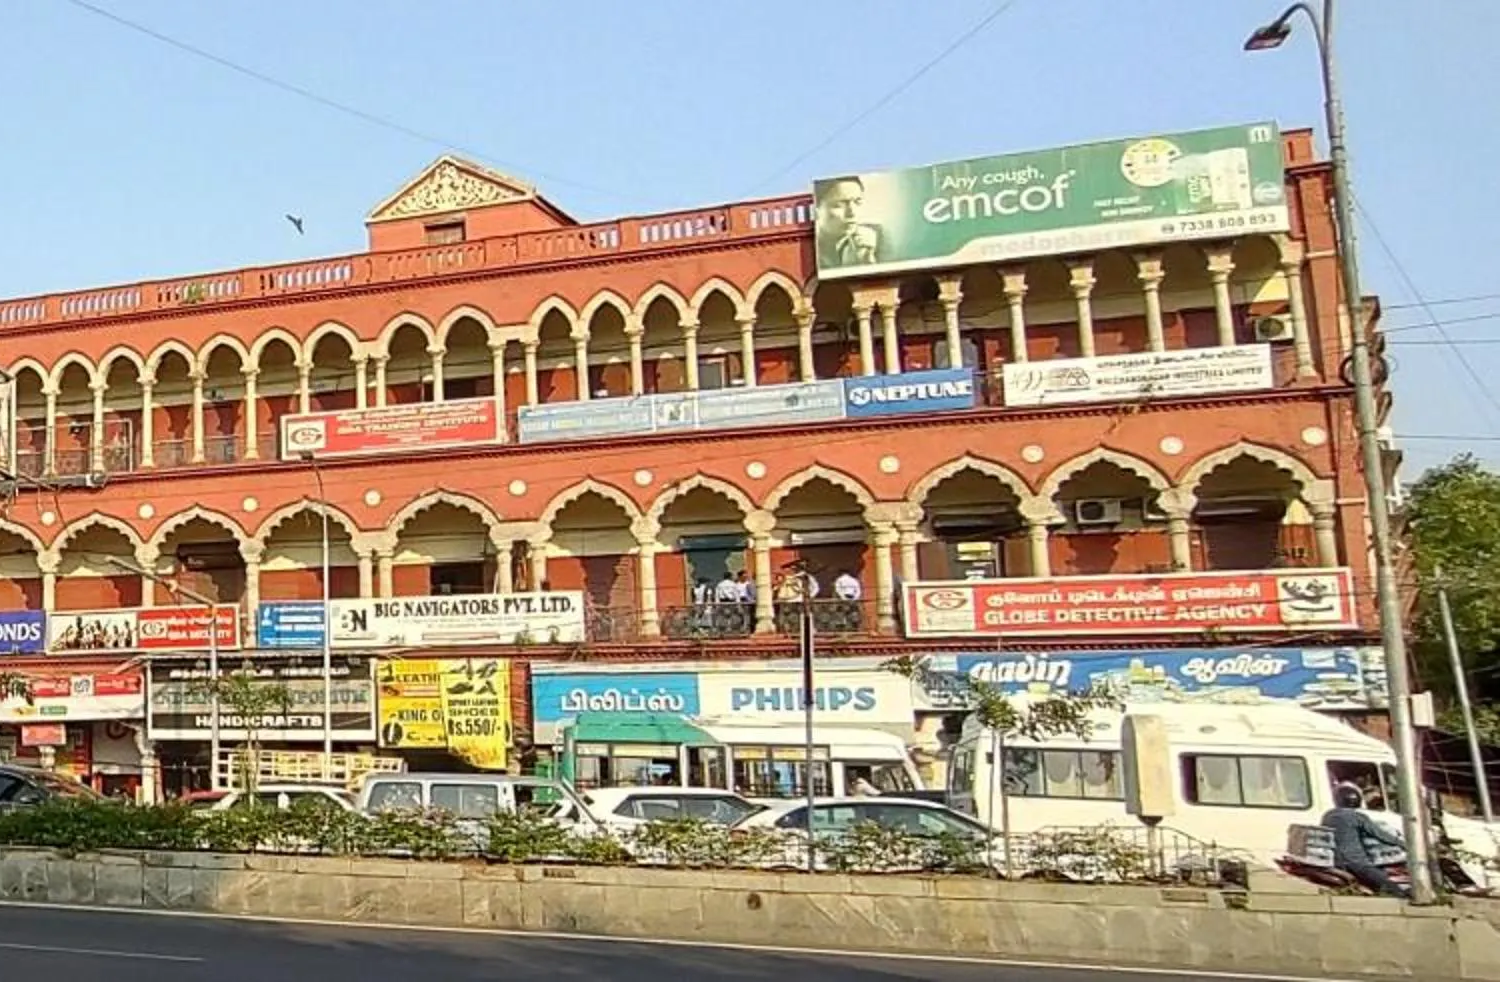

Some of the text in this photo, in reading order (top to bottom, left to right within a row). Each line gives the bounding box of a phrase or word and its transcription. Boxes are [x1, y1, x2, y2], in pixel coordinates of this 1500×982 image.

[941, 165, 1045, 191] Any cough.
[923, 173, 1070, 223] emcof
[1180, 221, 1213, 232] 7338
[872, 379, 972, 402] NEPTUNE
[373, 602, 400, 618] BIG
[403, 599, 499, 617] NAVIGATORS
[541, 597, 576, 613] LTD.
[984, 604, 1267, 625] GLOBE DETECTIVE AGENCY
[189, 629, 232, 640] SECUITY
[395, 673, 440, 682] LEATH
[1180, 653, 1291, 682] ஆவின்
[561, 687, 685, 712] பிலிப்ஸ்
[398, 709, 444, 721] KING O
